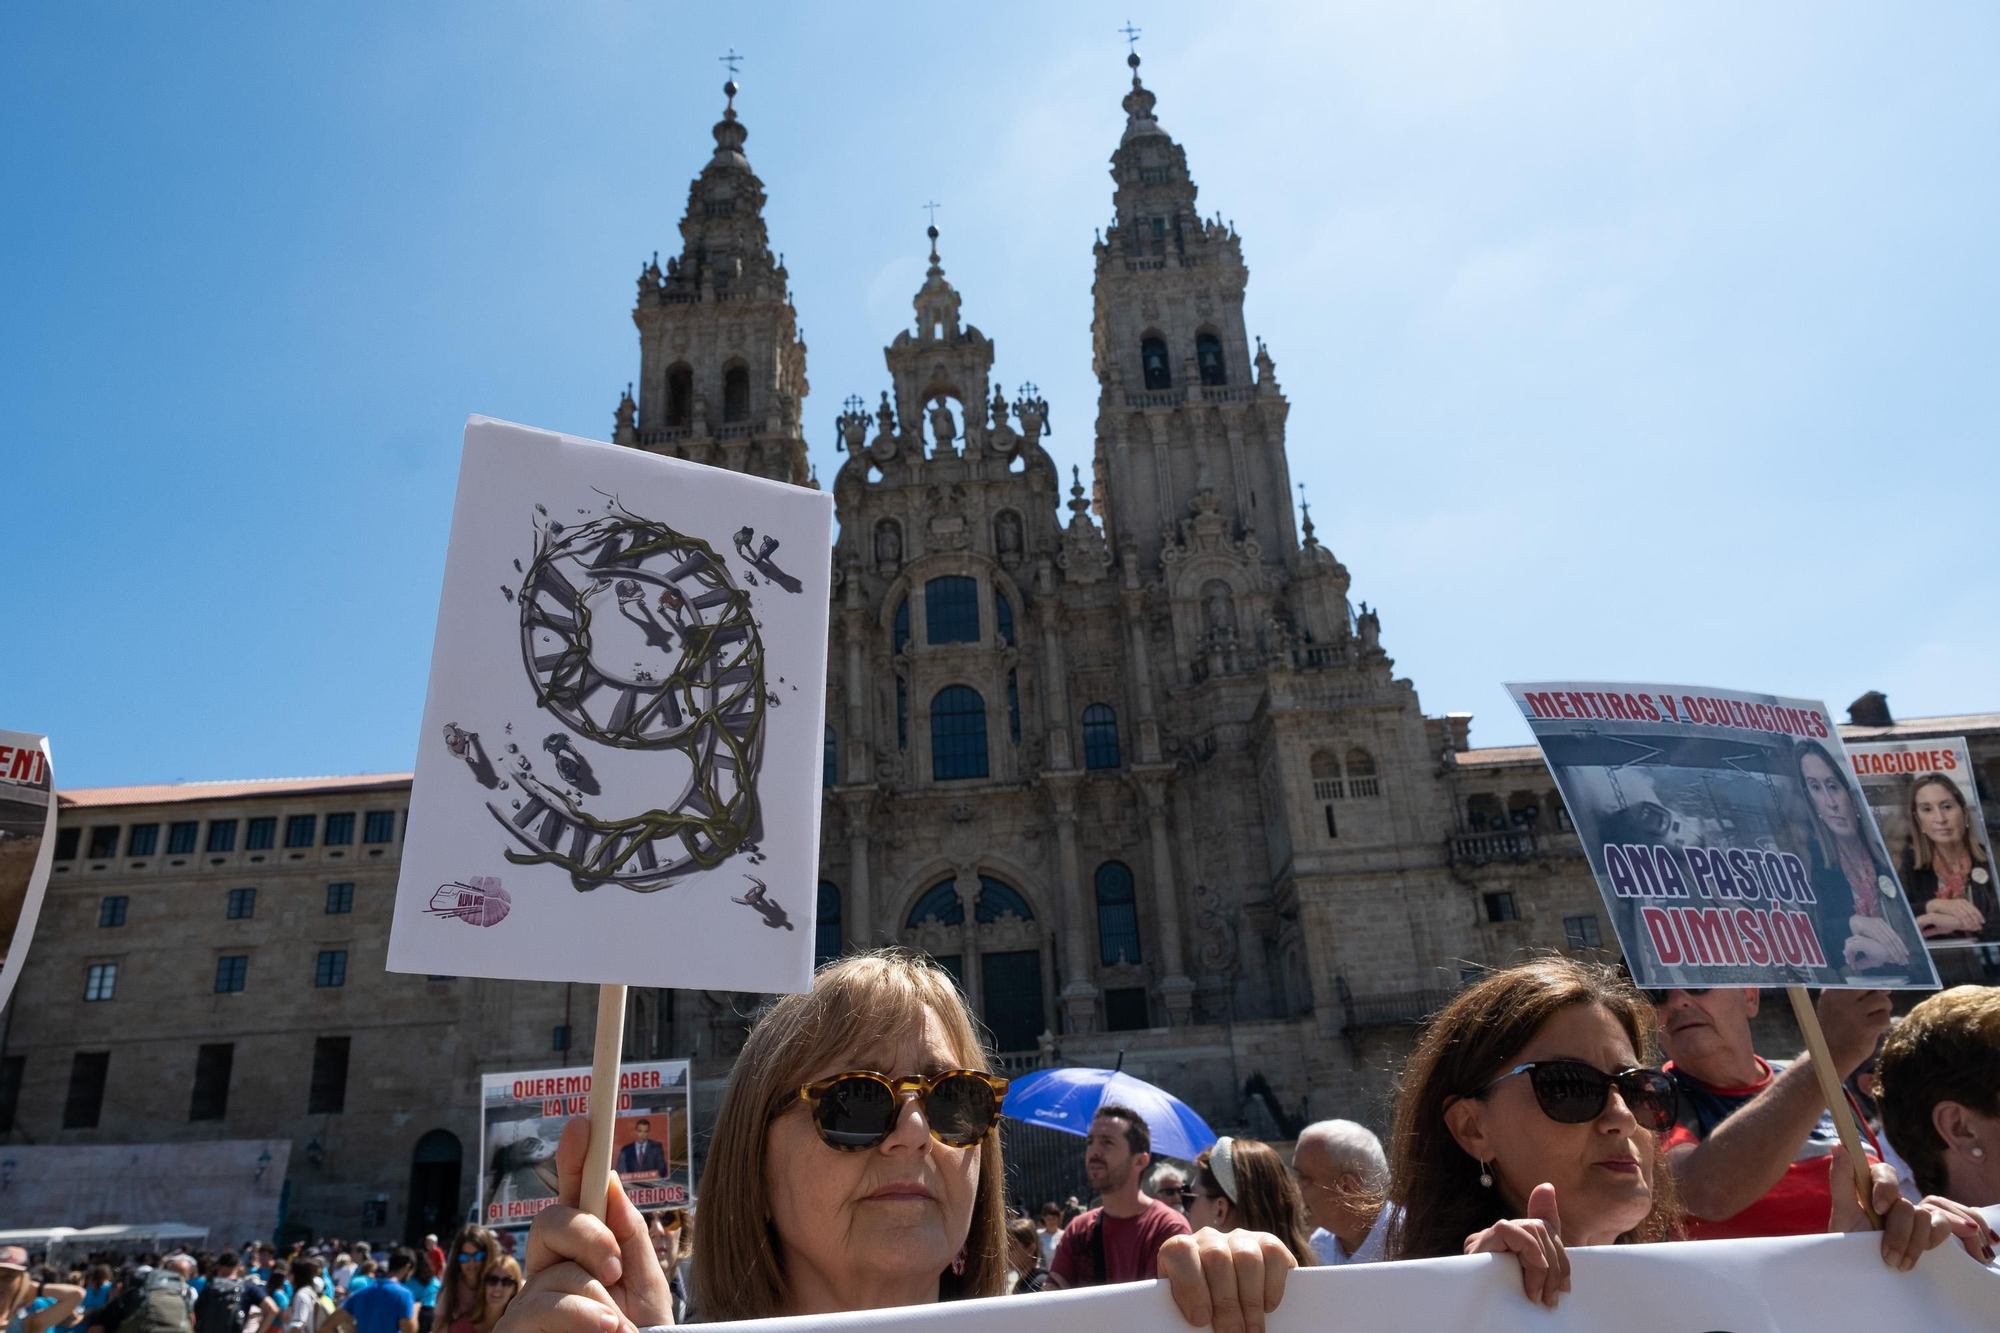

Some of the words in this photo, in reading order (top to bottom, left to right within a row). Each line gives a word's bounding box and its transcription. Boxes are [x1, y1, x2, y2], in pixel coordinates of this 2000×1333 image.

[1524, 692, 1661, 722] MENTIRAS
[1662, 694, 1681, 723] Y
[1682, 695, 1828, 740] OCULTACIONES
[1852, 749, 1957, 775] LTACIONES
[1604, 843, 1690, 898] ANA
[1682, 846, 1817, 904] PASTOR
[1641, 899, 1828, 968] DIMISIÓN
[513, 1076, 592, 1099] QUEREMO
[620, 1071, 660, 1090] ABER
[543, 1099, 562, 1117] LA
[489, 1203, 504, 1219] 81
[629, 1186, 684, 1205] HERIDOS
